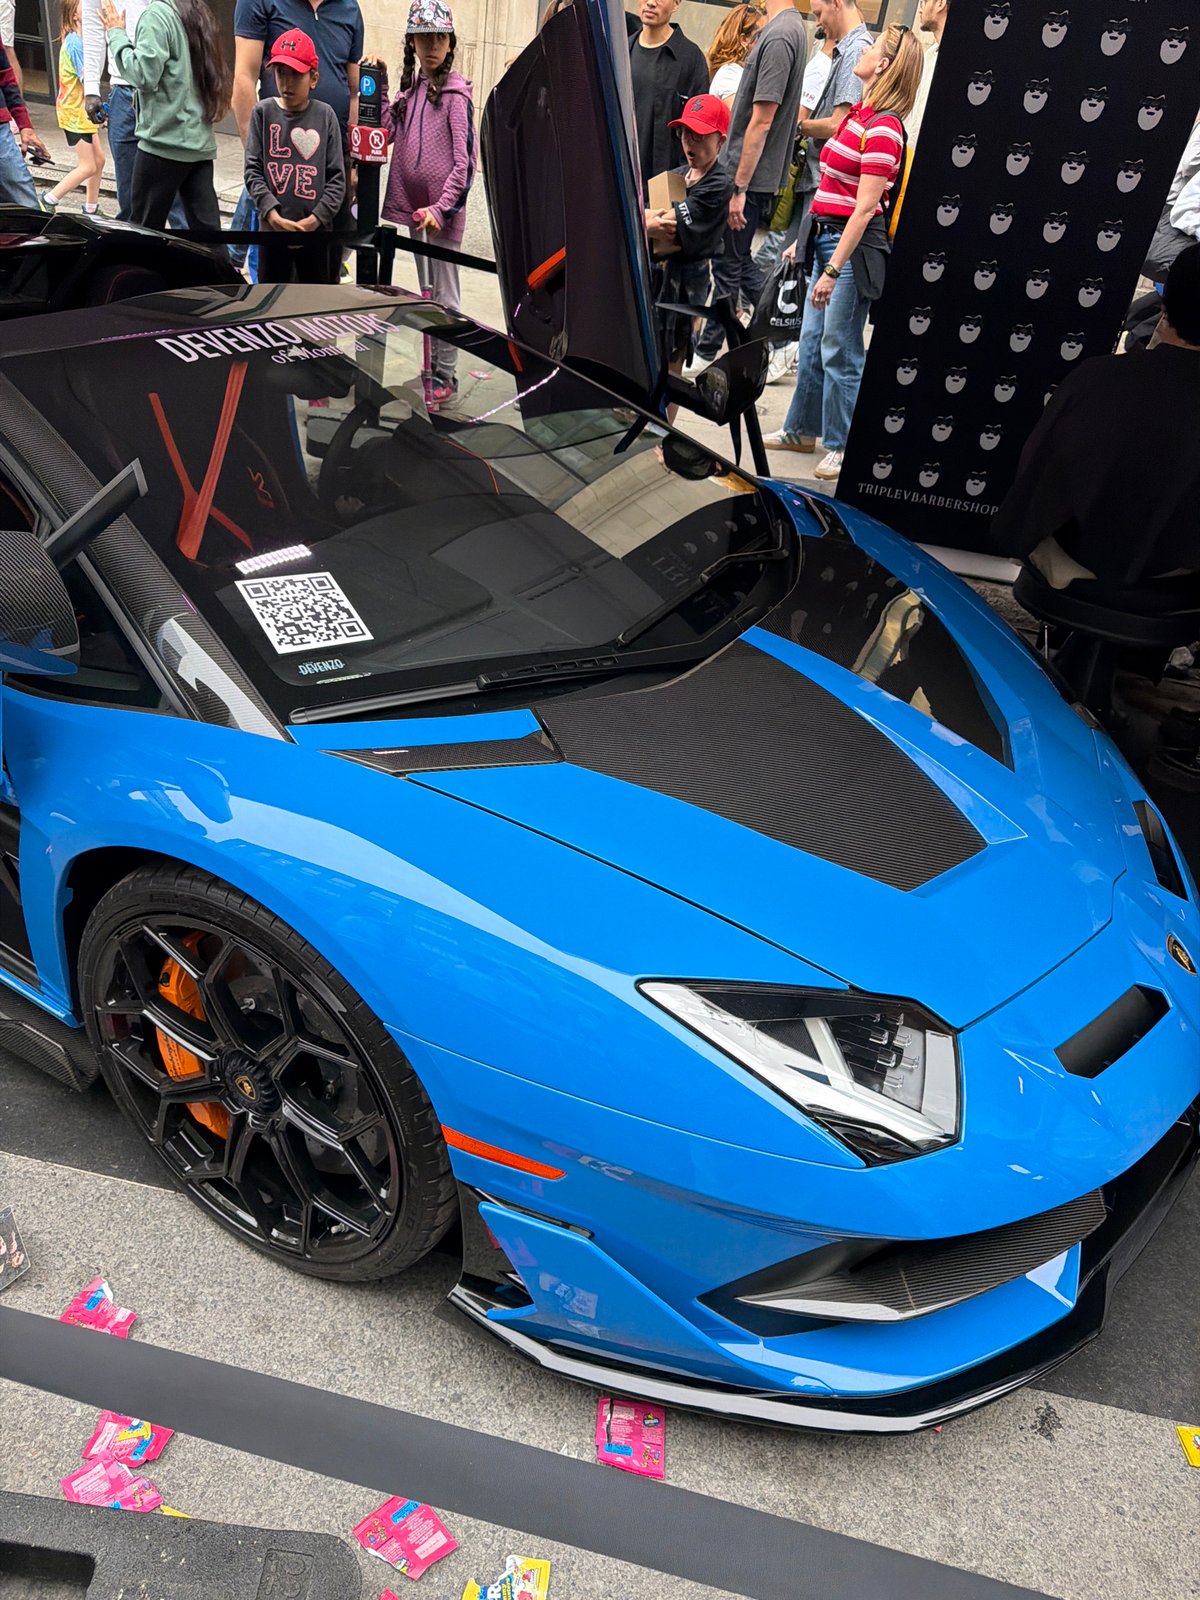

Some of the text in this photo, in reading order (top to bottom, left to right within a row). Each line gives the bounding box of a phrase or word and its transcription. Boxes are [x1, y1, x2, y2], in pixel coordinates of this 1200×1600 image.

[770, 316, 802, 327] CELSIUS
[154, 312, 400, 363] DEVENZO MOTORS
[271, 339, 371, 364] of Montal
[857, 482, 999, 516] TRIPLEVBARBERSHOP
[298, 658, 345, 676] DEVENZO
